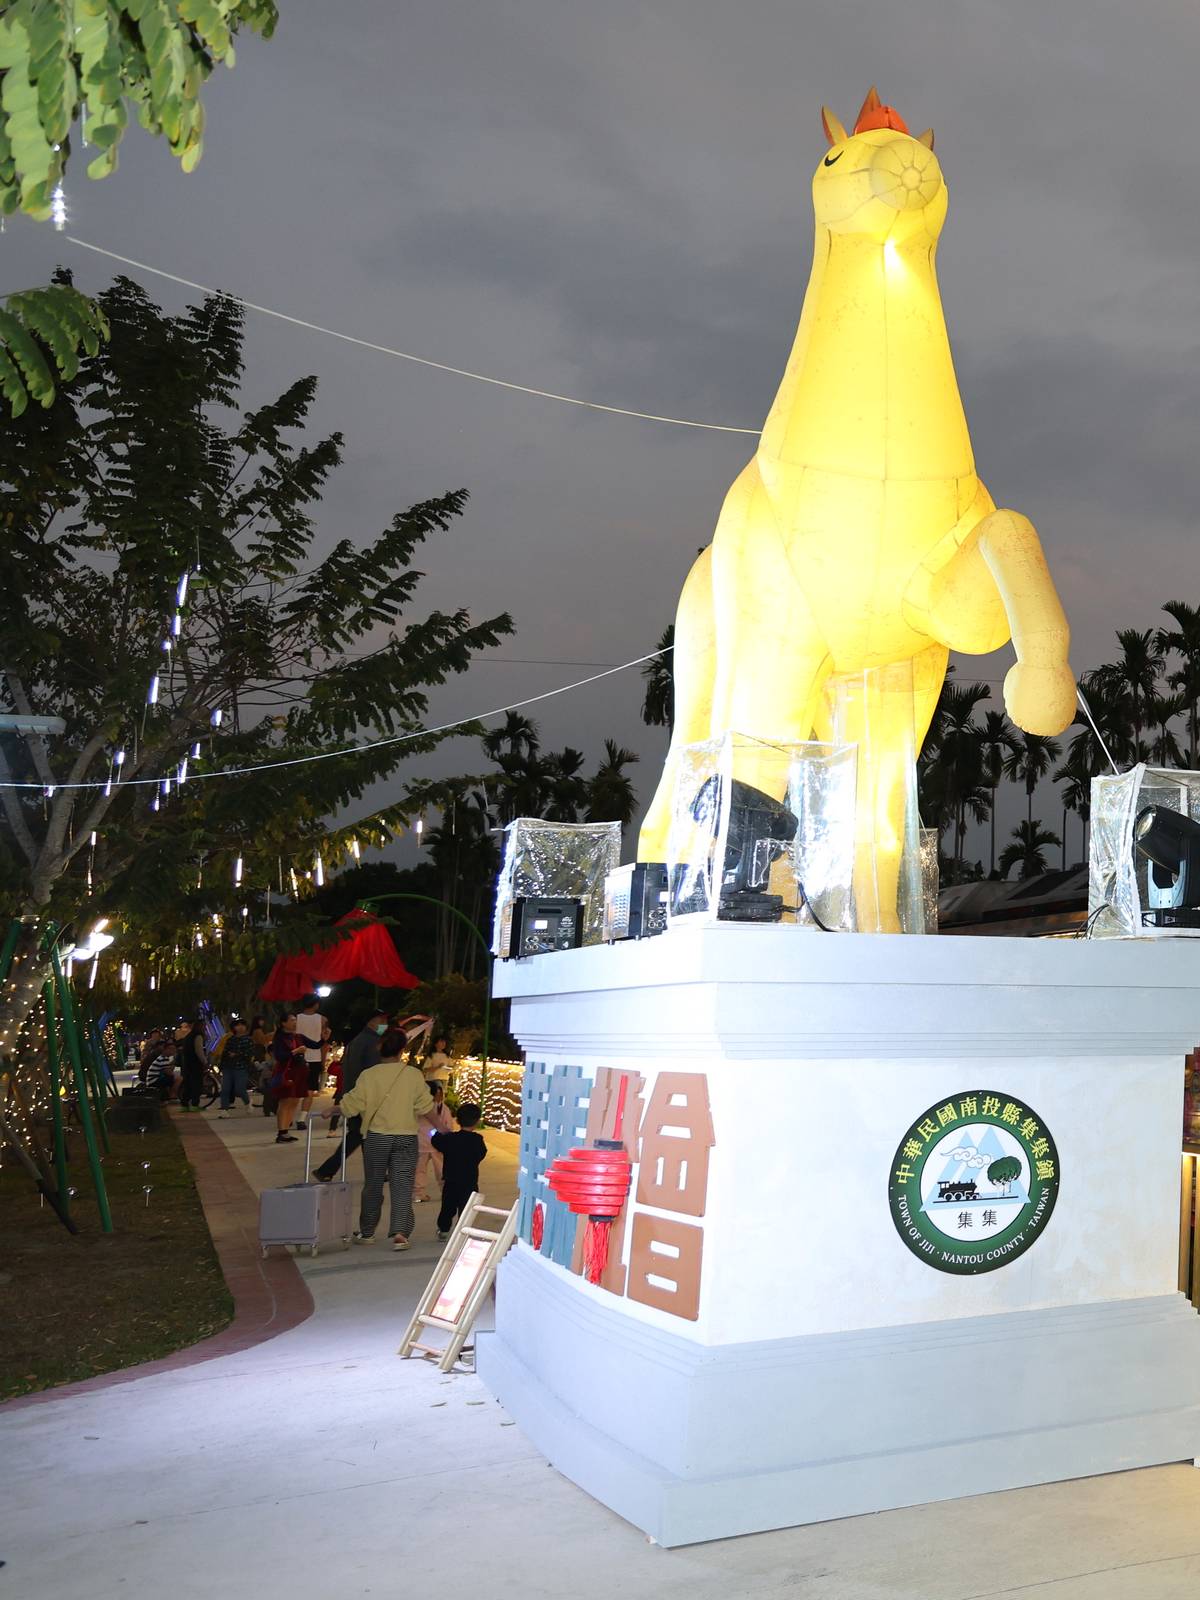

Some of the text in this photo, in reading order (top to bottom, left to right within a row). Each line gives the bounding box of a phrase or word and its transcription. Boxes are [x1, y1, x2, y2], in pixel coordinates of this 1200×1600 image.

[898, 1187, 1050, 1264] TOWN OF JIJI NANTOU COUNTY TAIWAN
[957, 1209, 998, 1229] 集集
